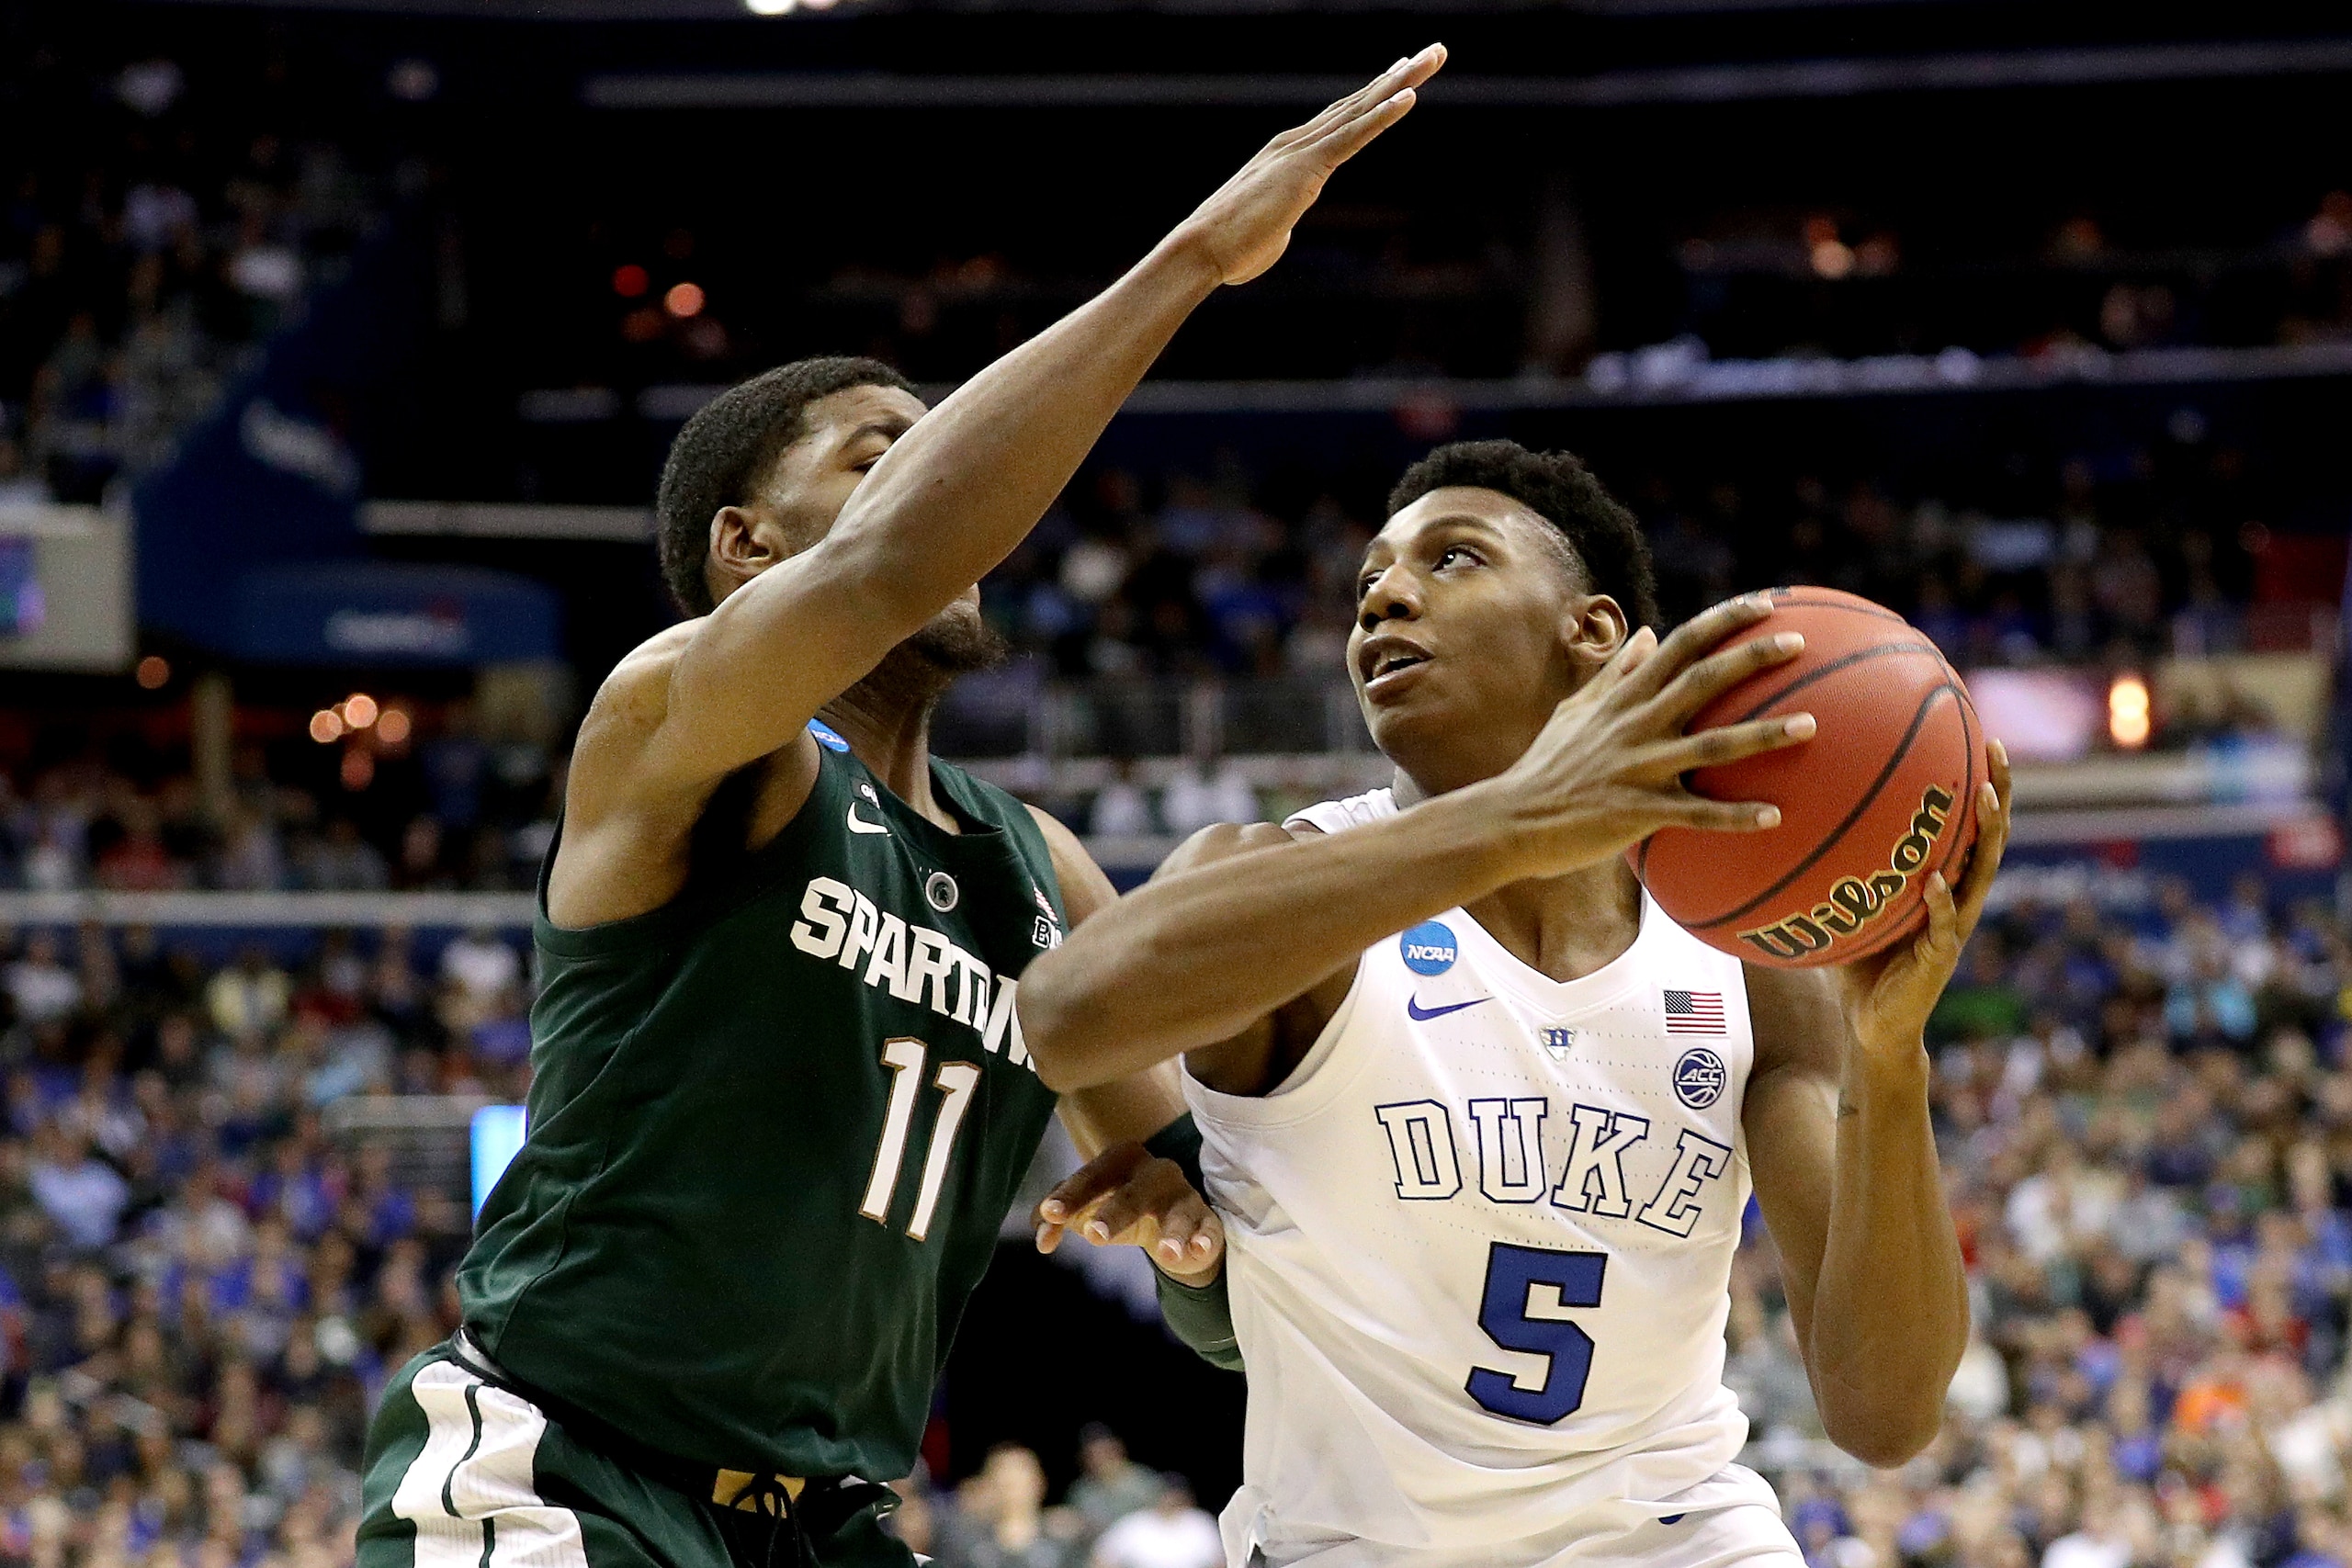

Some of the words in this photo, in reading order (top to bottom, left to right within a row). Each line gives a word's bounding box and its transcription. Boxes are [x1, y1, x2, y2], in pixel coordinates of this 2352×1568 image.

[1408, 944, 1455, 962] NCAA
[1737, 783, 1955, 960] Wilson
[790, 876, 1035, 1073] SPARTAN
[858, 1035, 982, 1242] 11
[1681, 1068, 1723, 1081] ACC
[1374, 1098, 1733, 1238] DUKE
[1464, 1241, 1608, 1426] 5
